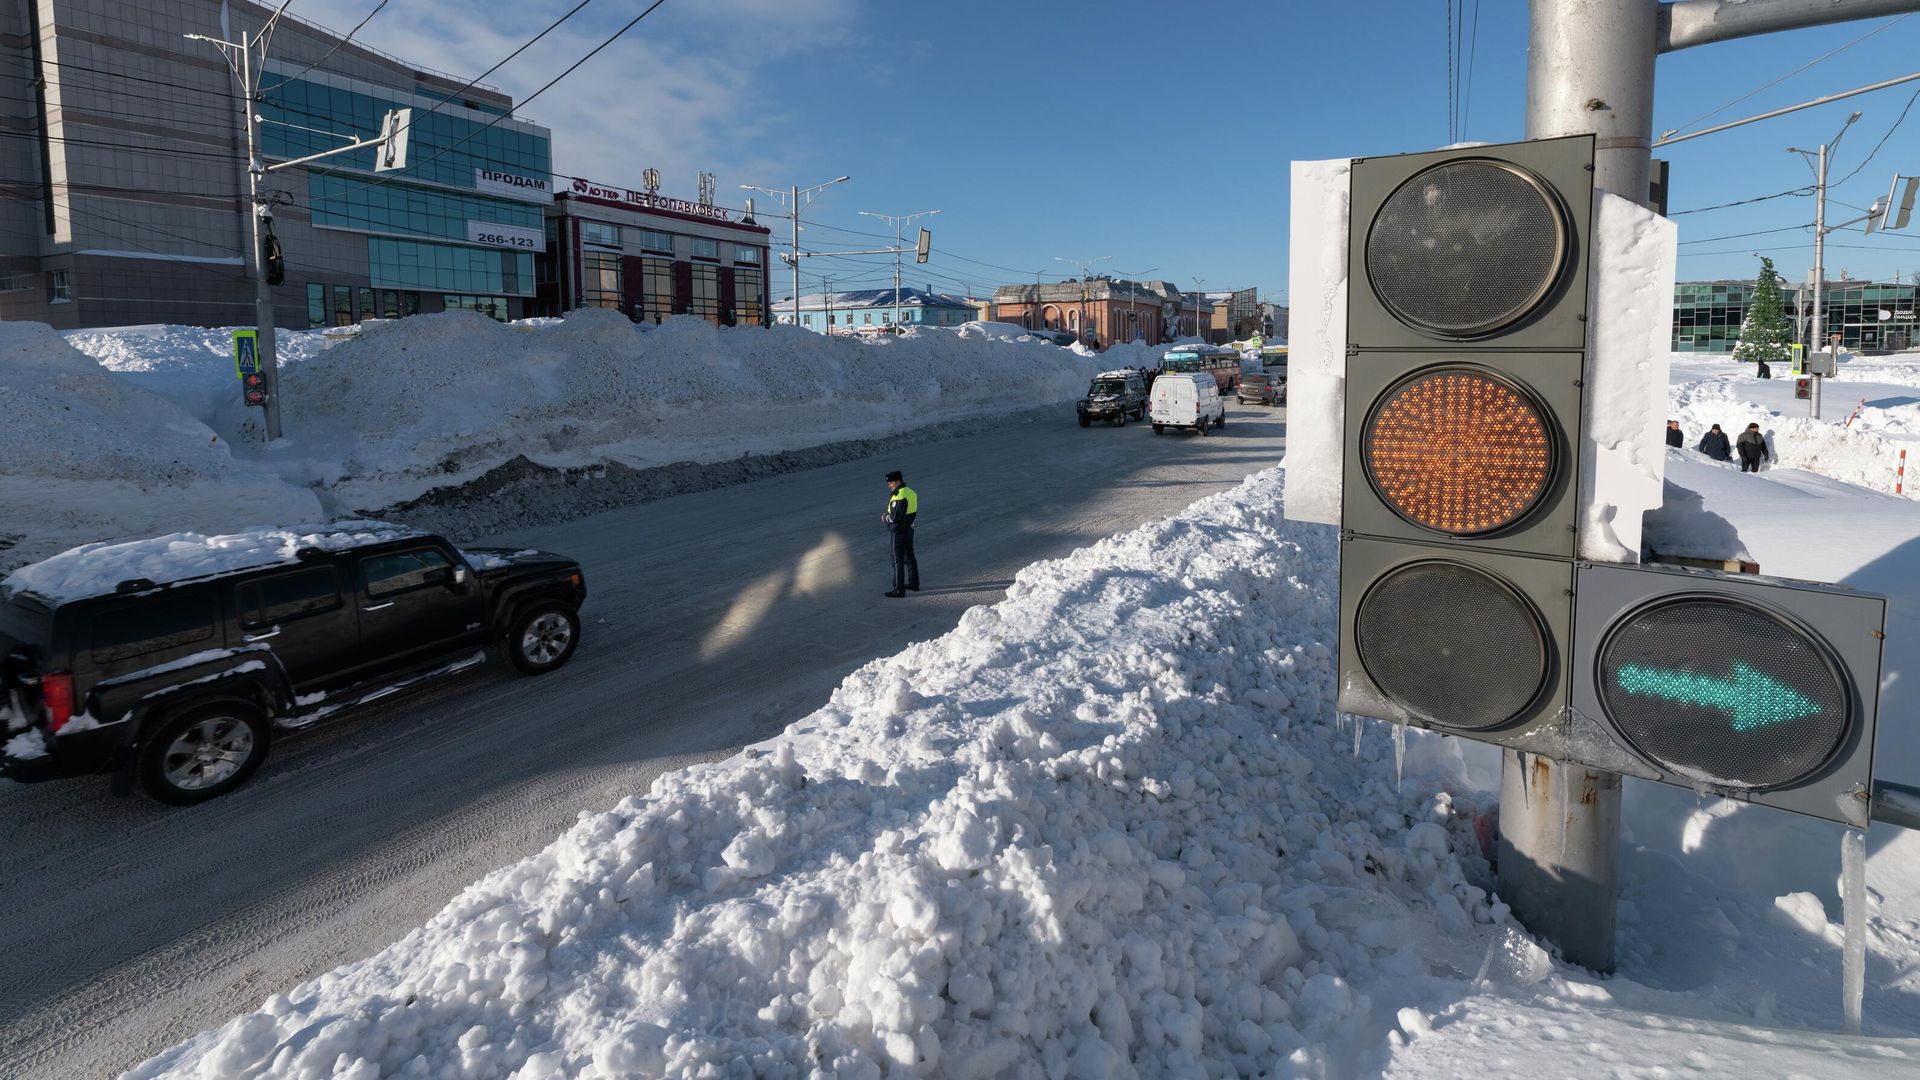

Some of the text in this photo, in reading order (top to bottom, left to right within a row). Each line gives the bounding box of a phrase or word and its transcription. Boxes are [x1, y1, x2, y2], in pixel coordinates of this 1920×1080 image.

[482, 170, 545, 190] ПРОДАМ
[589, 187, 728, 220] АО ТКФ ПЕТРОПАВЛОВСК
[477, 233, 534, 247] 266-123
